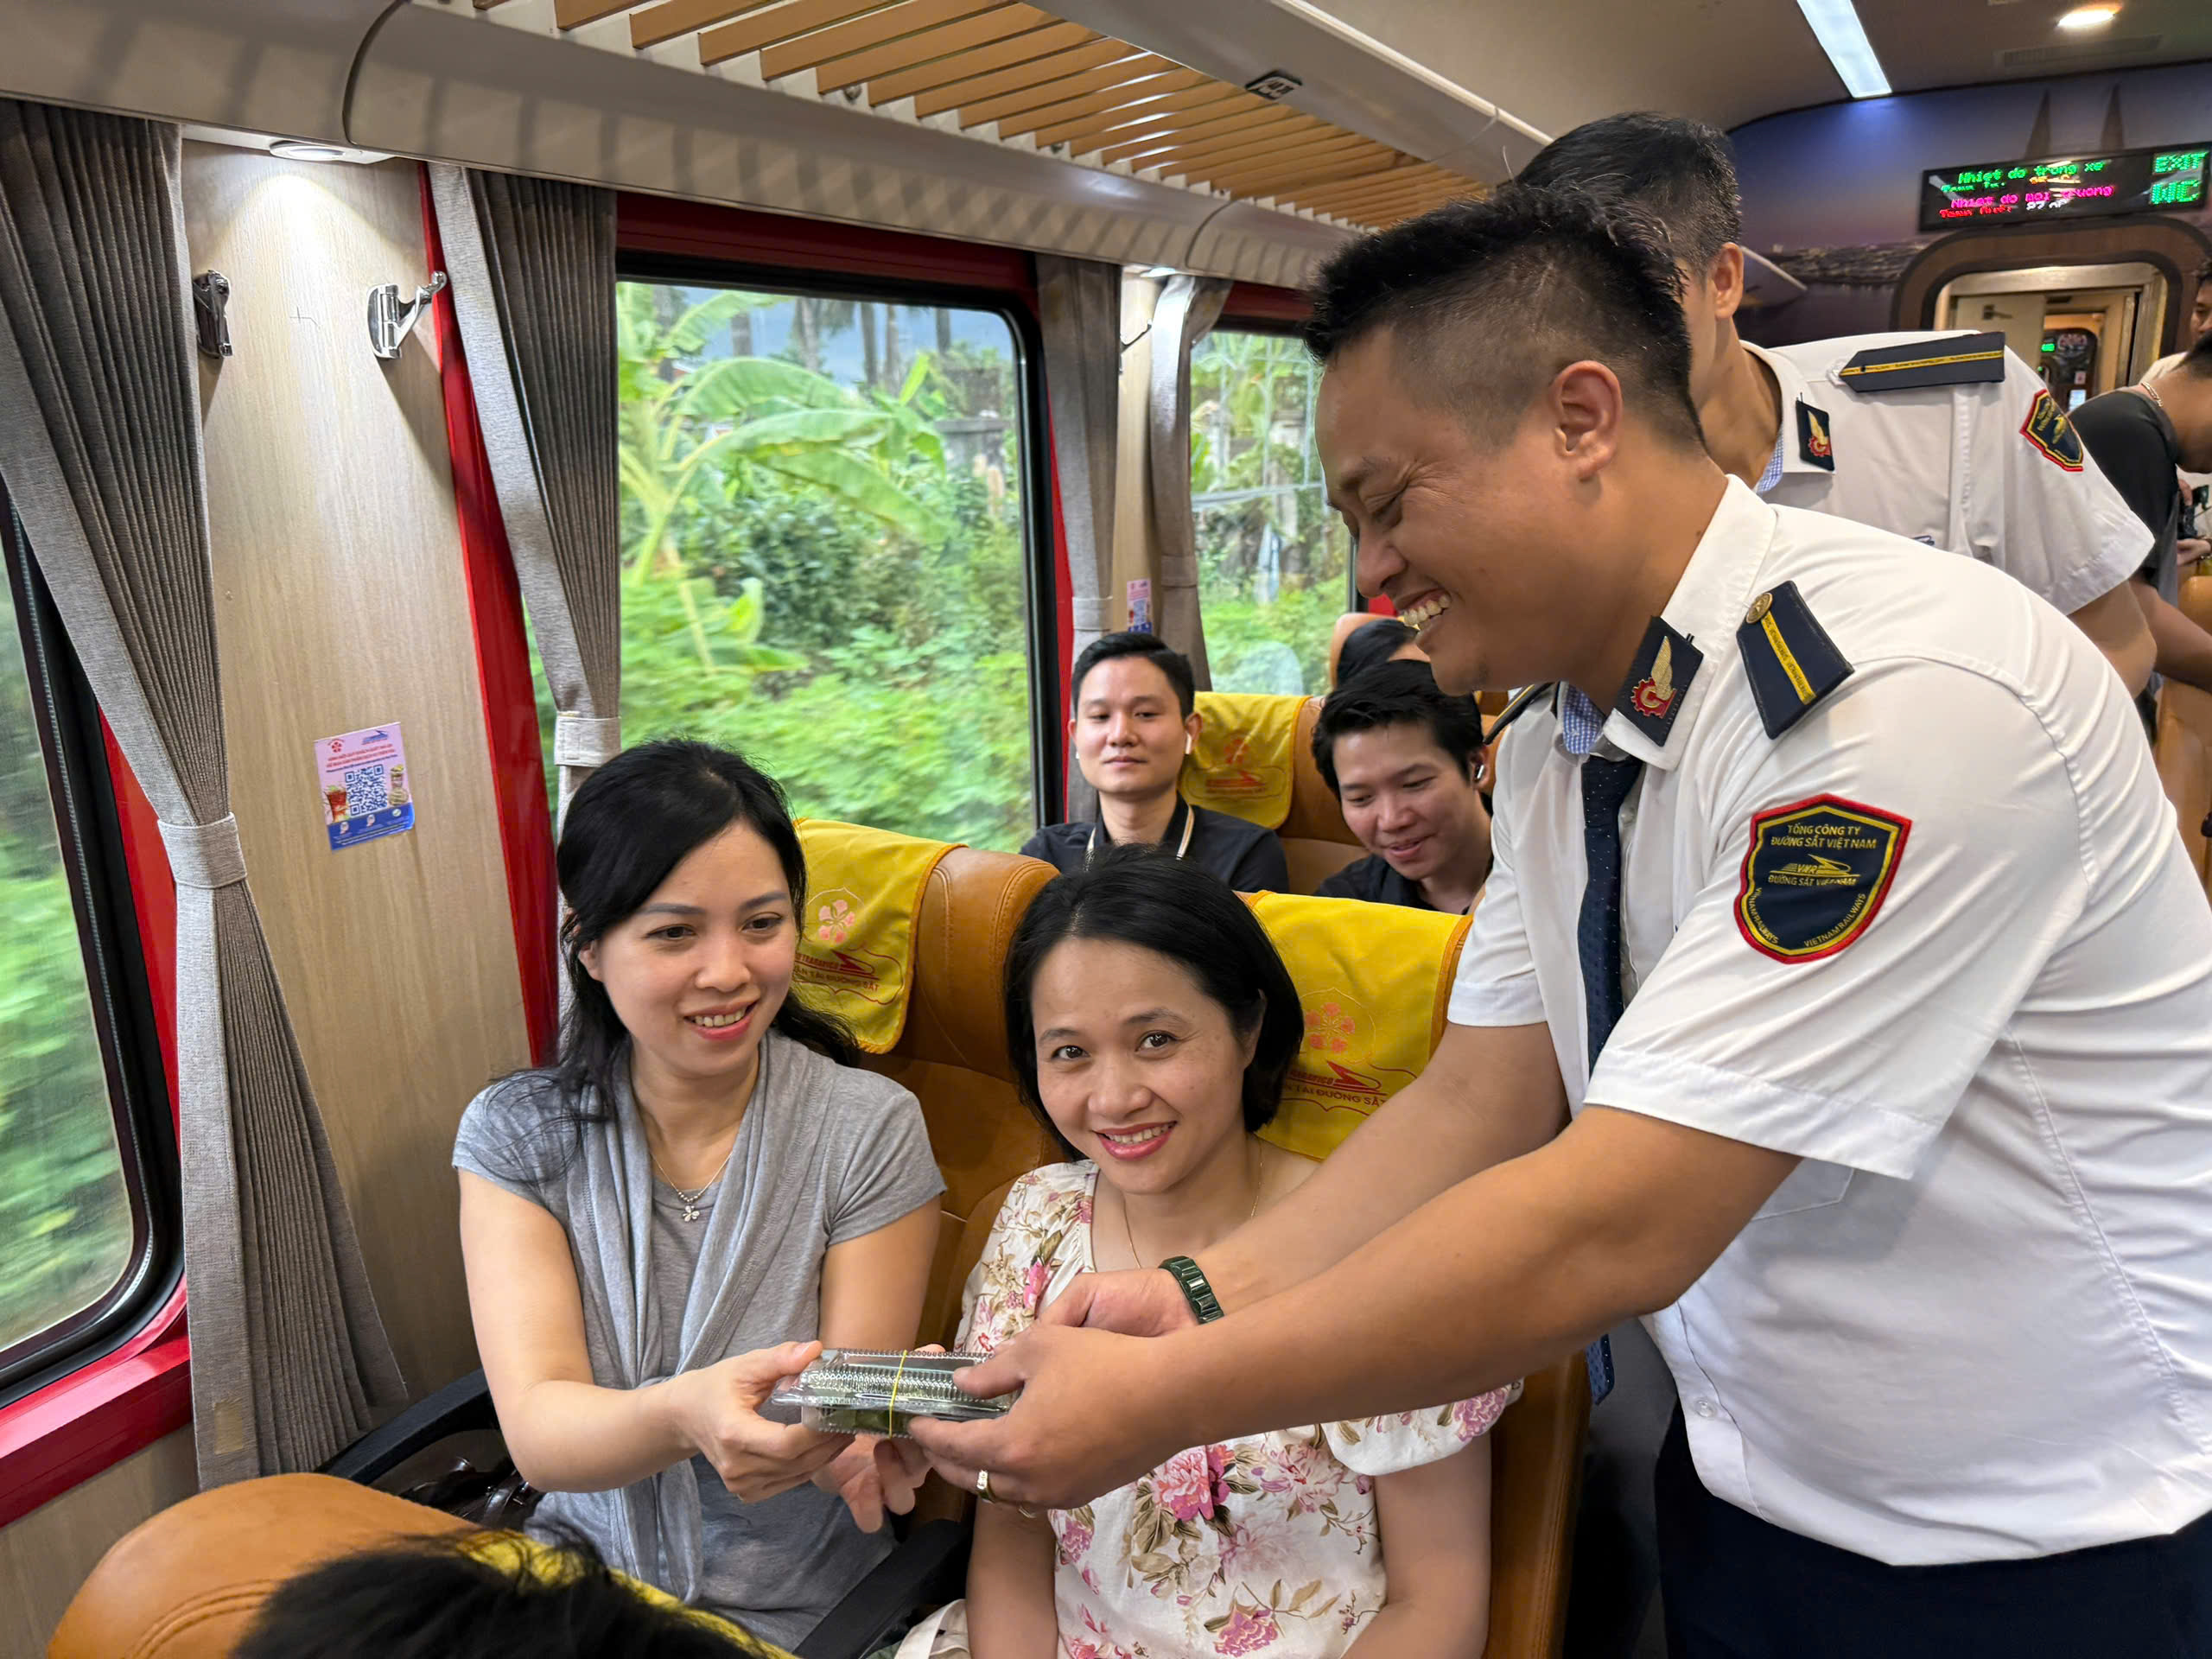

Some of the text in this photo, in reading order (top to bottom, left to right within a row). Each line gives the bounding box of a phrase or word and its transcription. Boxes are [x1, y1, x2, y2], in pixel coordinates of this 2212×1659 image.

[2155, 153, 2207, 173] EXIT
[1958, 169, 2002, 184] Nhiet
[2008, 167, 2026, 179] do
[2084, 162, 2104, 172] xe
[2000, 194, 2018, 204] do
[2152, 180, 2199, 204] WC
[1815, 823, 1845, 836] CÔNG
[1847, 826, 1861, 835] TY
[1850, 839, 1877, 849] NAM
